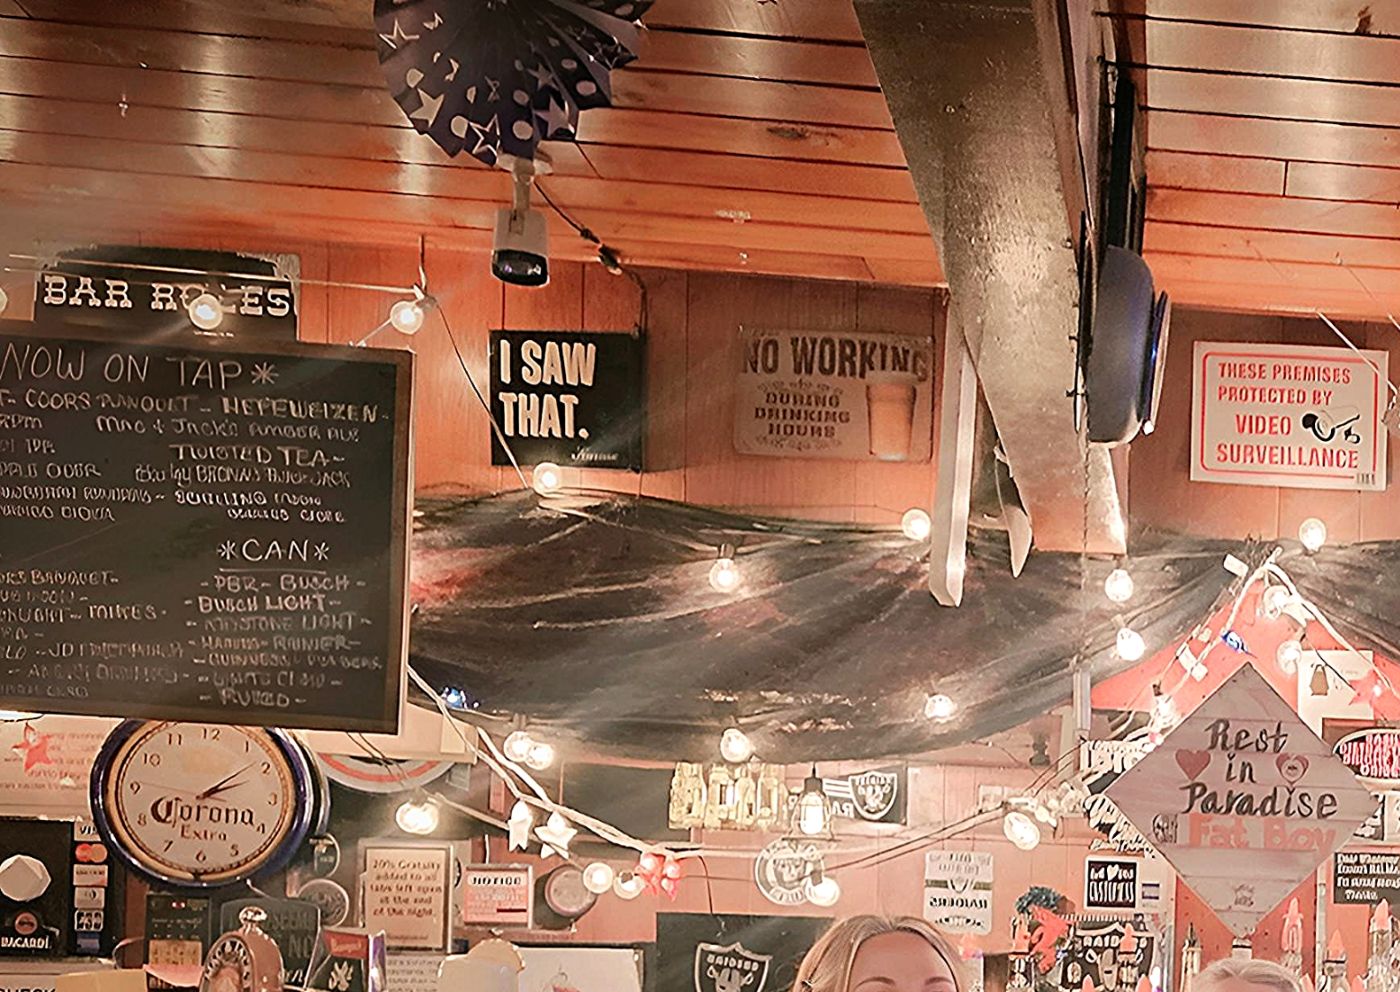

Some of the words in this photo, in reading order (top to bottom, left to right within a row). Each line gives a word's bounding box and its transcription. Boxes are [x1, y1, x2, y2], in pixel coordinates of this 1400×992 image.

[43, 275, 133, 309] BAR
[151, 282, 291, 318] RES
[0, 342, 85, 383] NOW
[104, 354, 150, 383] ON
[167, 356, 243, 390] TAP
[499, 338, 512, 385] I
[521, 341, 597, 387] SAW
[744, 339, 779, 375] NO
[790, 337, 927, 382] WORKING
[1218, 362, 1268, 381] THESE
[1272, 363, 1351, 385] PREMISES
[25, 388, 92, 411] COORS
[766, 392, 840, 408] DURING
[1217, 385, 1307, 405] PROTECTED
[1311, 389, 1333, 406] BY
[499, 392, 589, 440] THAT.
[755, 408, 850, 423] DRINKING
[1235, 413, 1292, 436] VIDEO
[769, 423, 835, 438] HOURS
[169, 444, 272, 465] TWISTED
[276, 446, 330, 468] TEA
[1216, 443, 1360, 469] SURVEILLANCE
[242, 538, 309, 562] CAN
[280, 573, 350, 592] BUSCH
[265, 593, 326, 612] LIGHT
[167, 733, 182, 746] 11
[202, 729, 220, 741] 12
[244, 740, 250, 752] 1
[1204, 719, 1288, 753] Rest
[142, 752, 161, 767] 10
[260, 761, 271, 775] 2
[1225, 754, 1257, 783] in
[129, 781, 141, 795] 9
[267, 793, 278, 806] 3
[1179, 782, 1338, 818] Paradise
[150, 796, 256, 828] Corona
[80, 825, 100, 836] VIS
[180, 825, 228, 842] Extra
[1190, 814, 1248, 848] Fat
[1264, 817, 1337, 855] Boy
[398, 859, 441, 872] Gratuity
